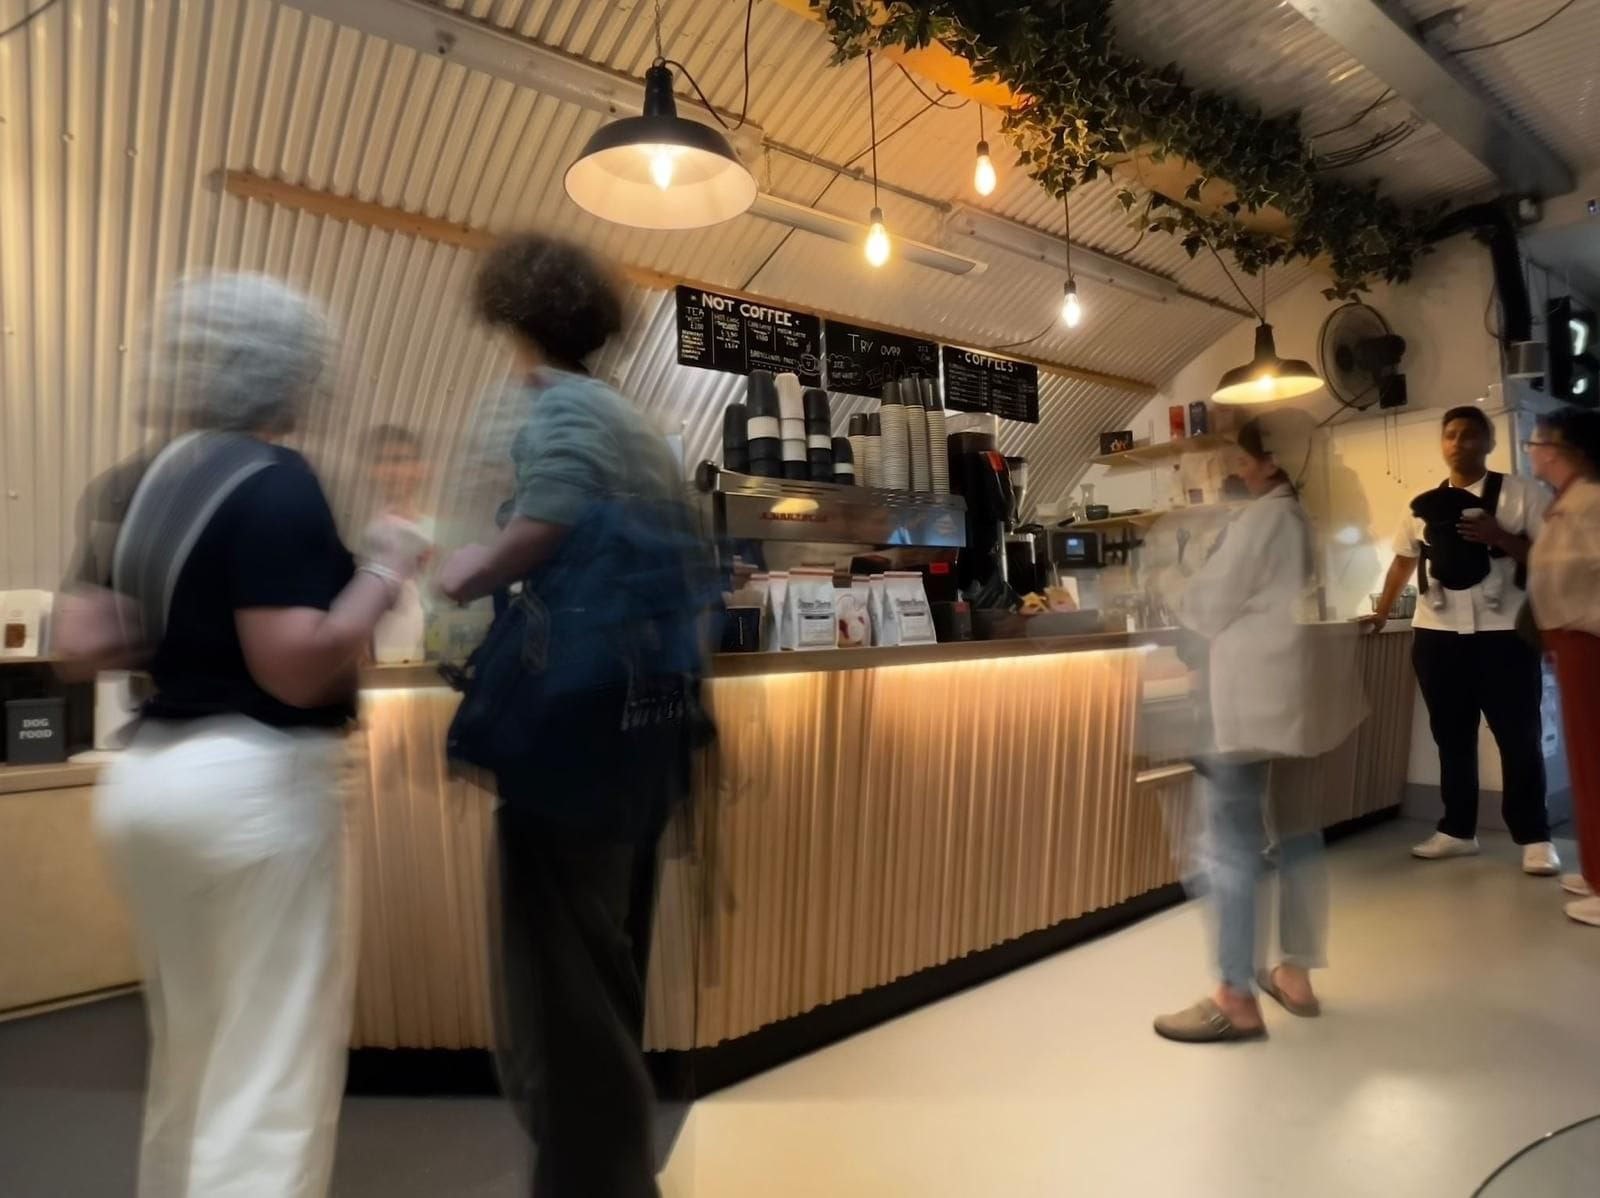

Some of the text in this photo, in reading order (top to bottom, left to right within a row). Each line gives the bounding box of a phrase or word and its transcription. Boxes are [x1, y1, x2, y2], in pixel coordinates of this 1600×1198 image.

[686, 306, 705, 317] TEA
[701, 292, 735, 313] NOT
[739, 303, 793, 327] COFFEE
[964, 352, 1014, 373] COFFEES
[23, 718, 49, 728] DOG
[19, 729, 53, 740] FOOD
